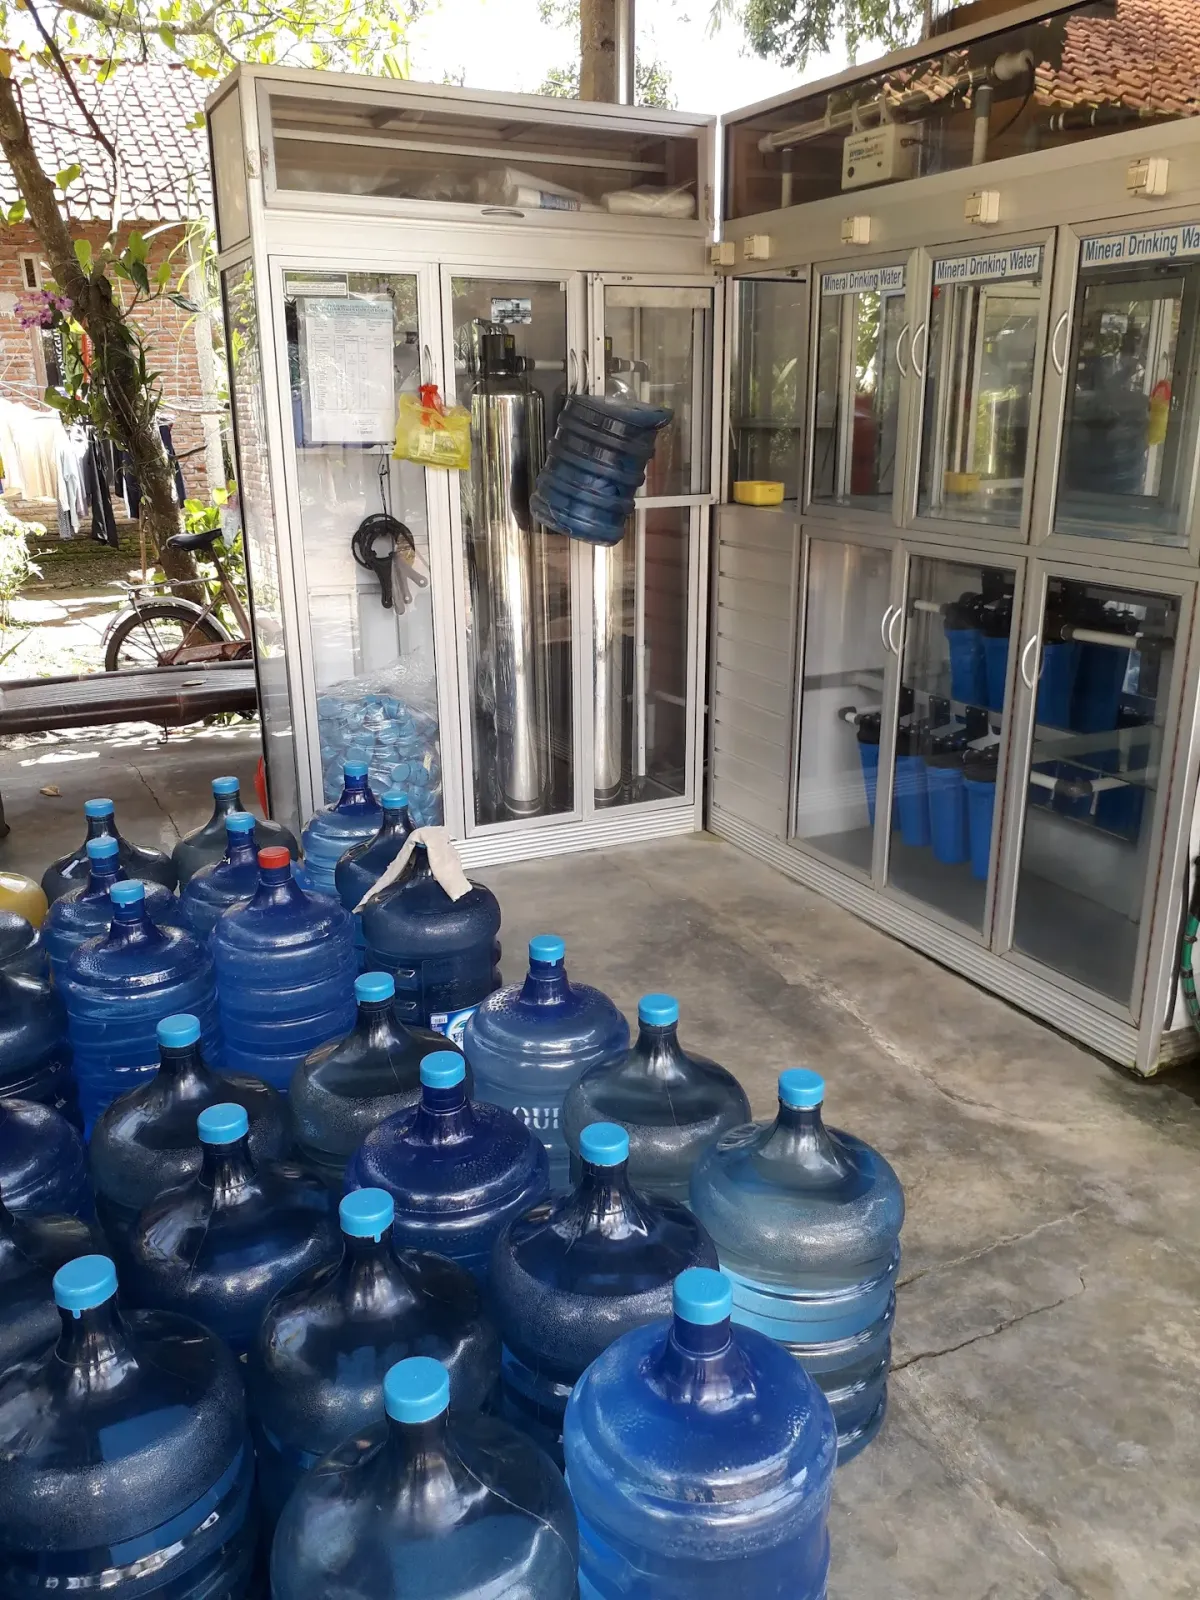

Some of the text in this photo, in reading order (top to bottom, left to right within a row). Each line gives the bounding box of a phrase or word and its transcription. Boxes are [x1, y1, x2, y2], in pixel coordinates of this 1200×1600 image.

[1085, 236, 1126, 261] Mineral
[1128, 232, 1178, 256] Drinking
[937, 251, 1037, 279] Mineral Drinking Water
[824, 269, 902, 291] Mineral Drinking Water
